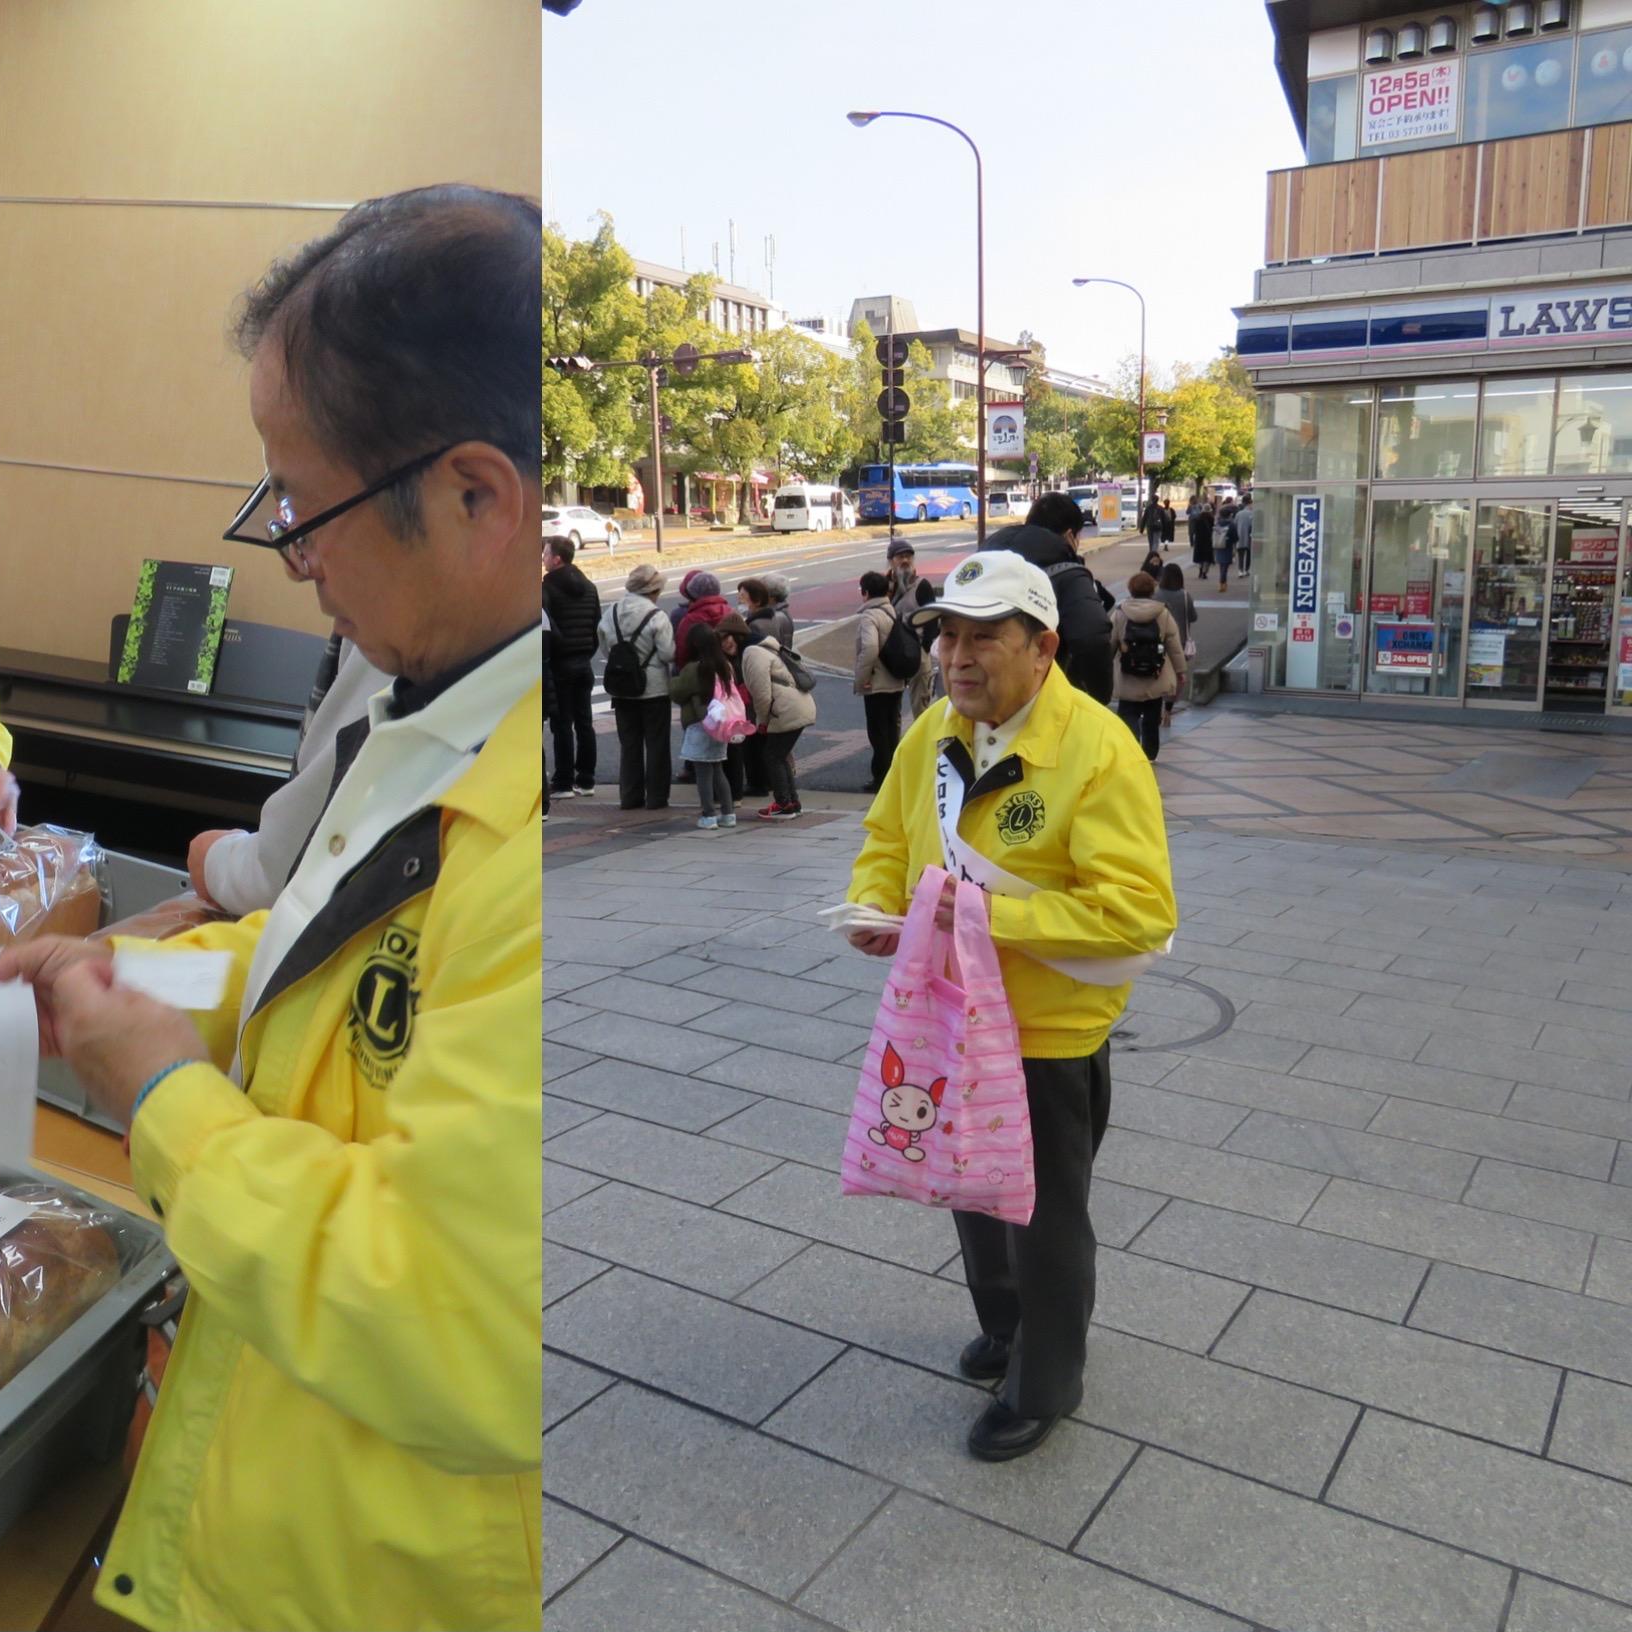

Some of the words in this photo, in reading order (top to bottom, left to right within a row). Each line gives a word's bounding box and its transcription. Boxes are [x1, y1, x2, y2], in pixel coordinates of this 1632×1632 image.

[1368, 86, 1451, 116] OPEN!!
[1296, 501, 1317, 608] LAWSON
[1407, 655, 1428, 663] OPEN
[366, 971, 399, 1044] L
